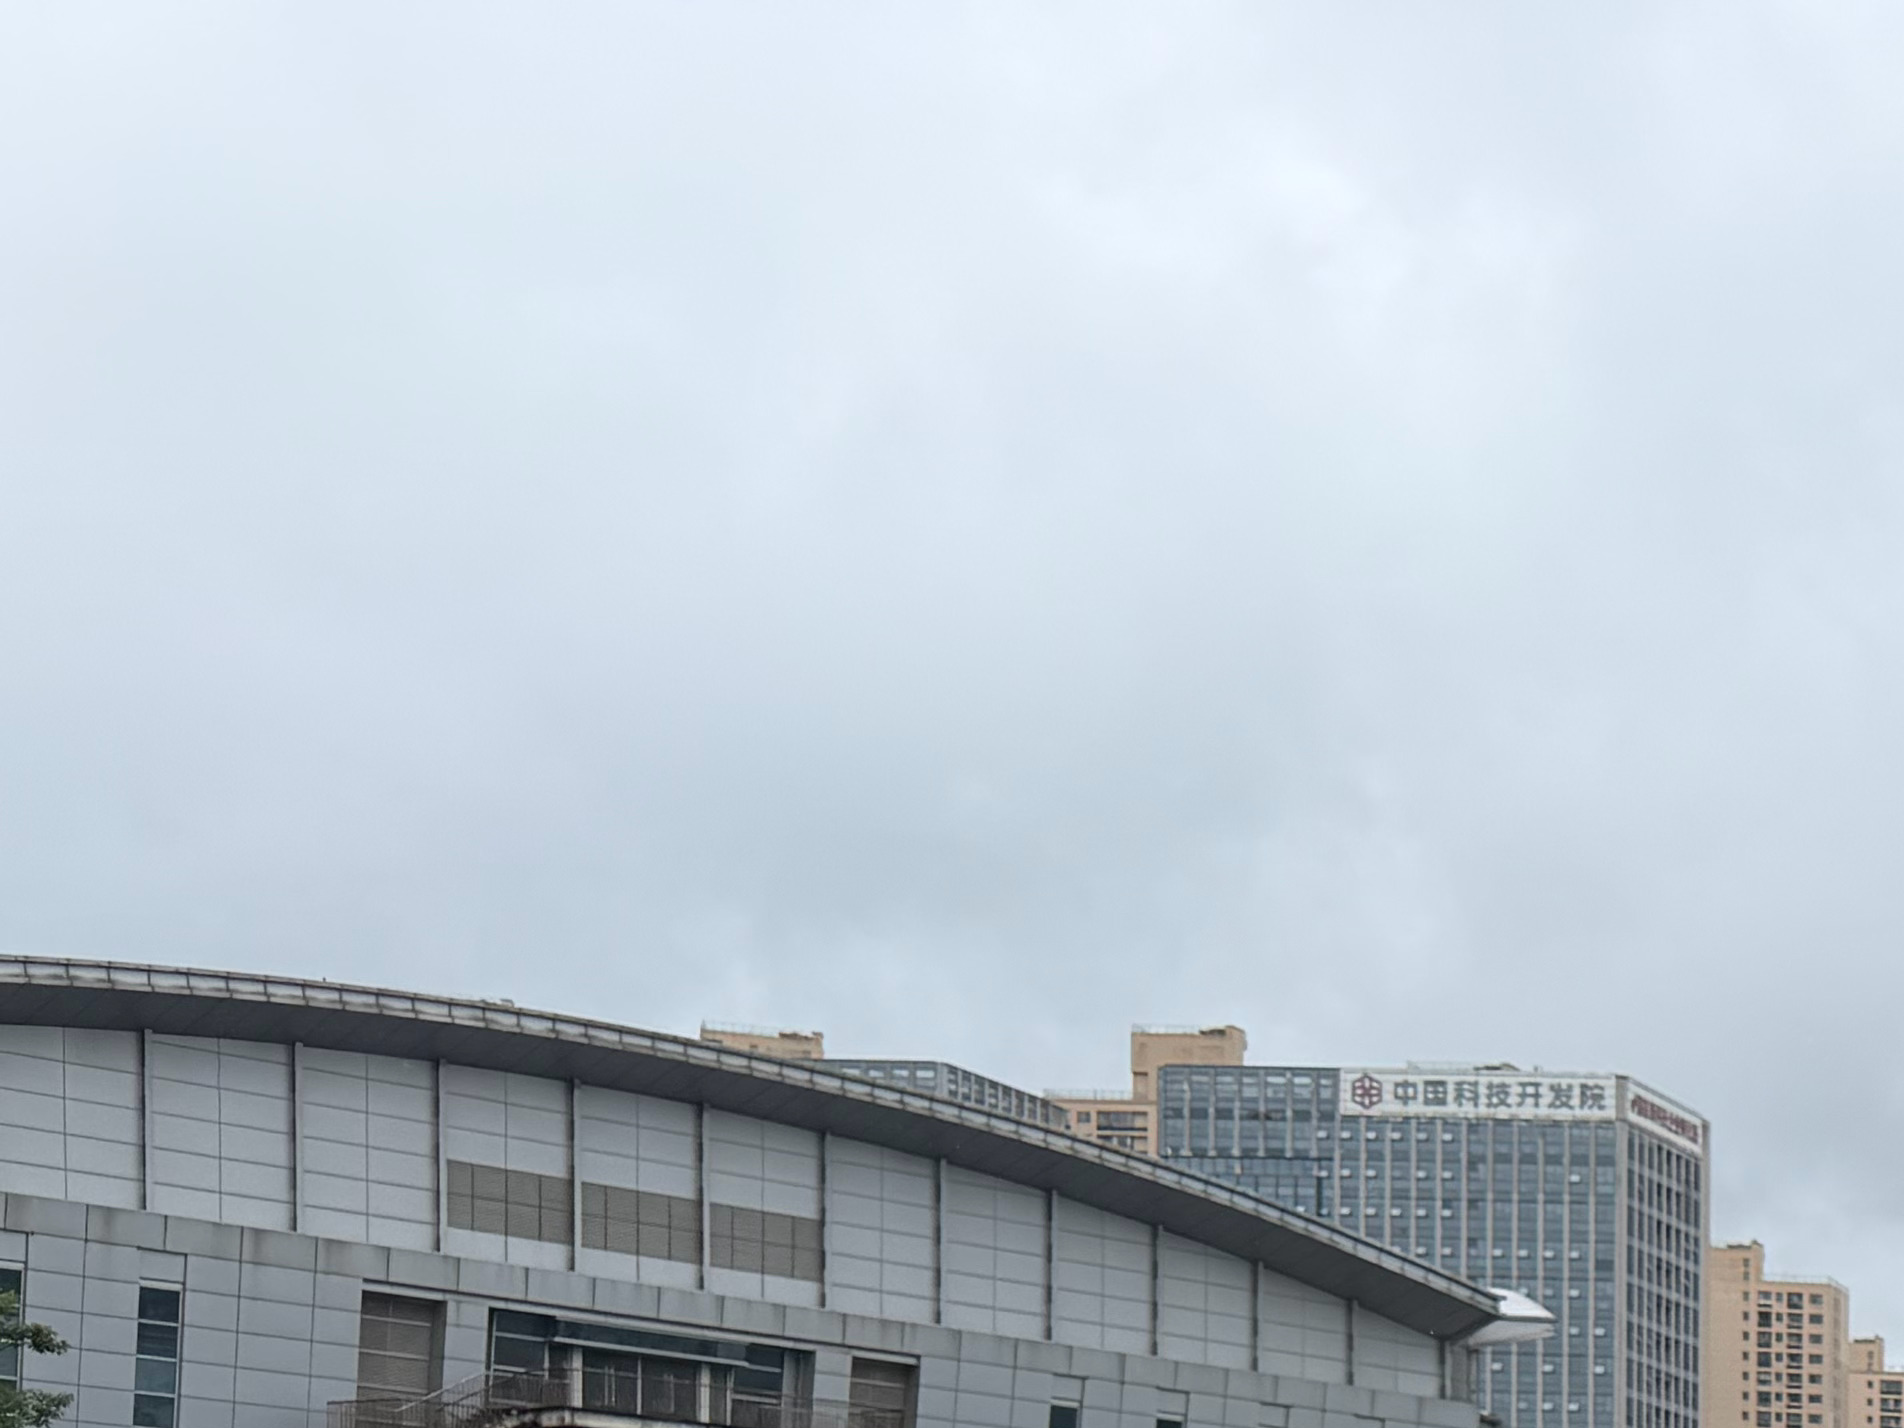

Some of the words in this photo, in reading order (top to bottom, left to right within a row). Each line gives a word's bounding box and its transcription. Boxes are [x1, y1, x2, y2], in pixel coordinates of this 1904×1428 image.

[1393, 1080, 1607, 1111] 中国科技开发院
